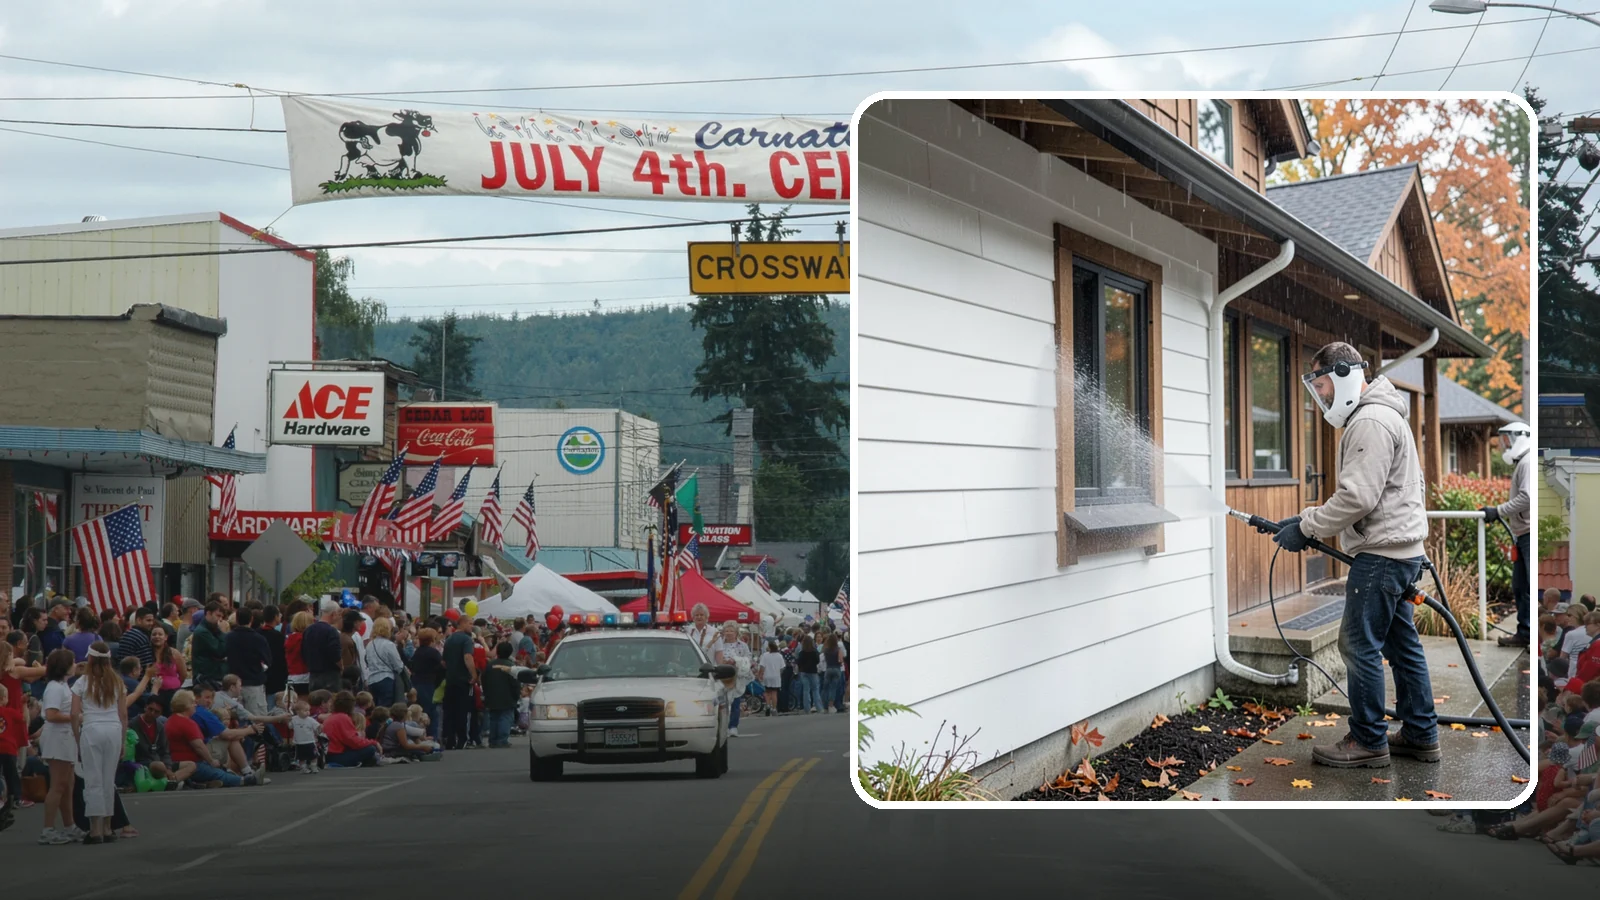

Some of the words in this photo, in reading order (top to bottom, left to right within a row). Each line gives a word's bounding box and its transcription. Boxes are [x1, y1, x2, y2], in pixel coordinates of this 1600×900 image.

[481, 141, 605, 193] JULY
[632, 149, 746, 198] 4th.
[697, 254, 850, 280] CROSSWA
[282, 380, 373, 420] ACE
[405, 409, 452, 422] CEDAR
[461, 409, 485, 422] LOG
[283, 421, 371, 436] Hardware
[416, 428, 477, 447] Coca-Cola
[353, 467, 385, 481] Simpl
[95, 485, 124, 495] Vincent
[126, 486, 136, 495] de
[137, 486, 155, 495] Paul
[688, 526, 741, 535] CRNATION
[699, 535, 730, 543] GLASS
